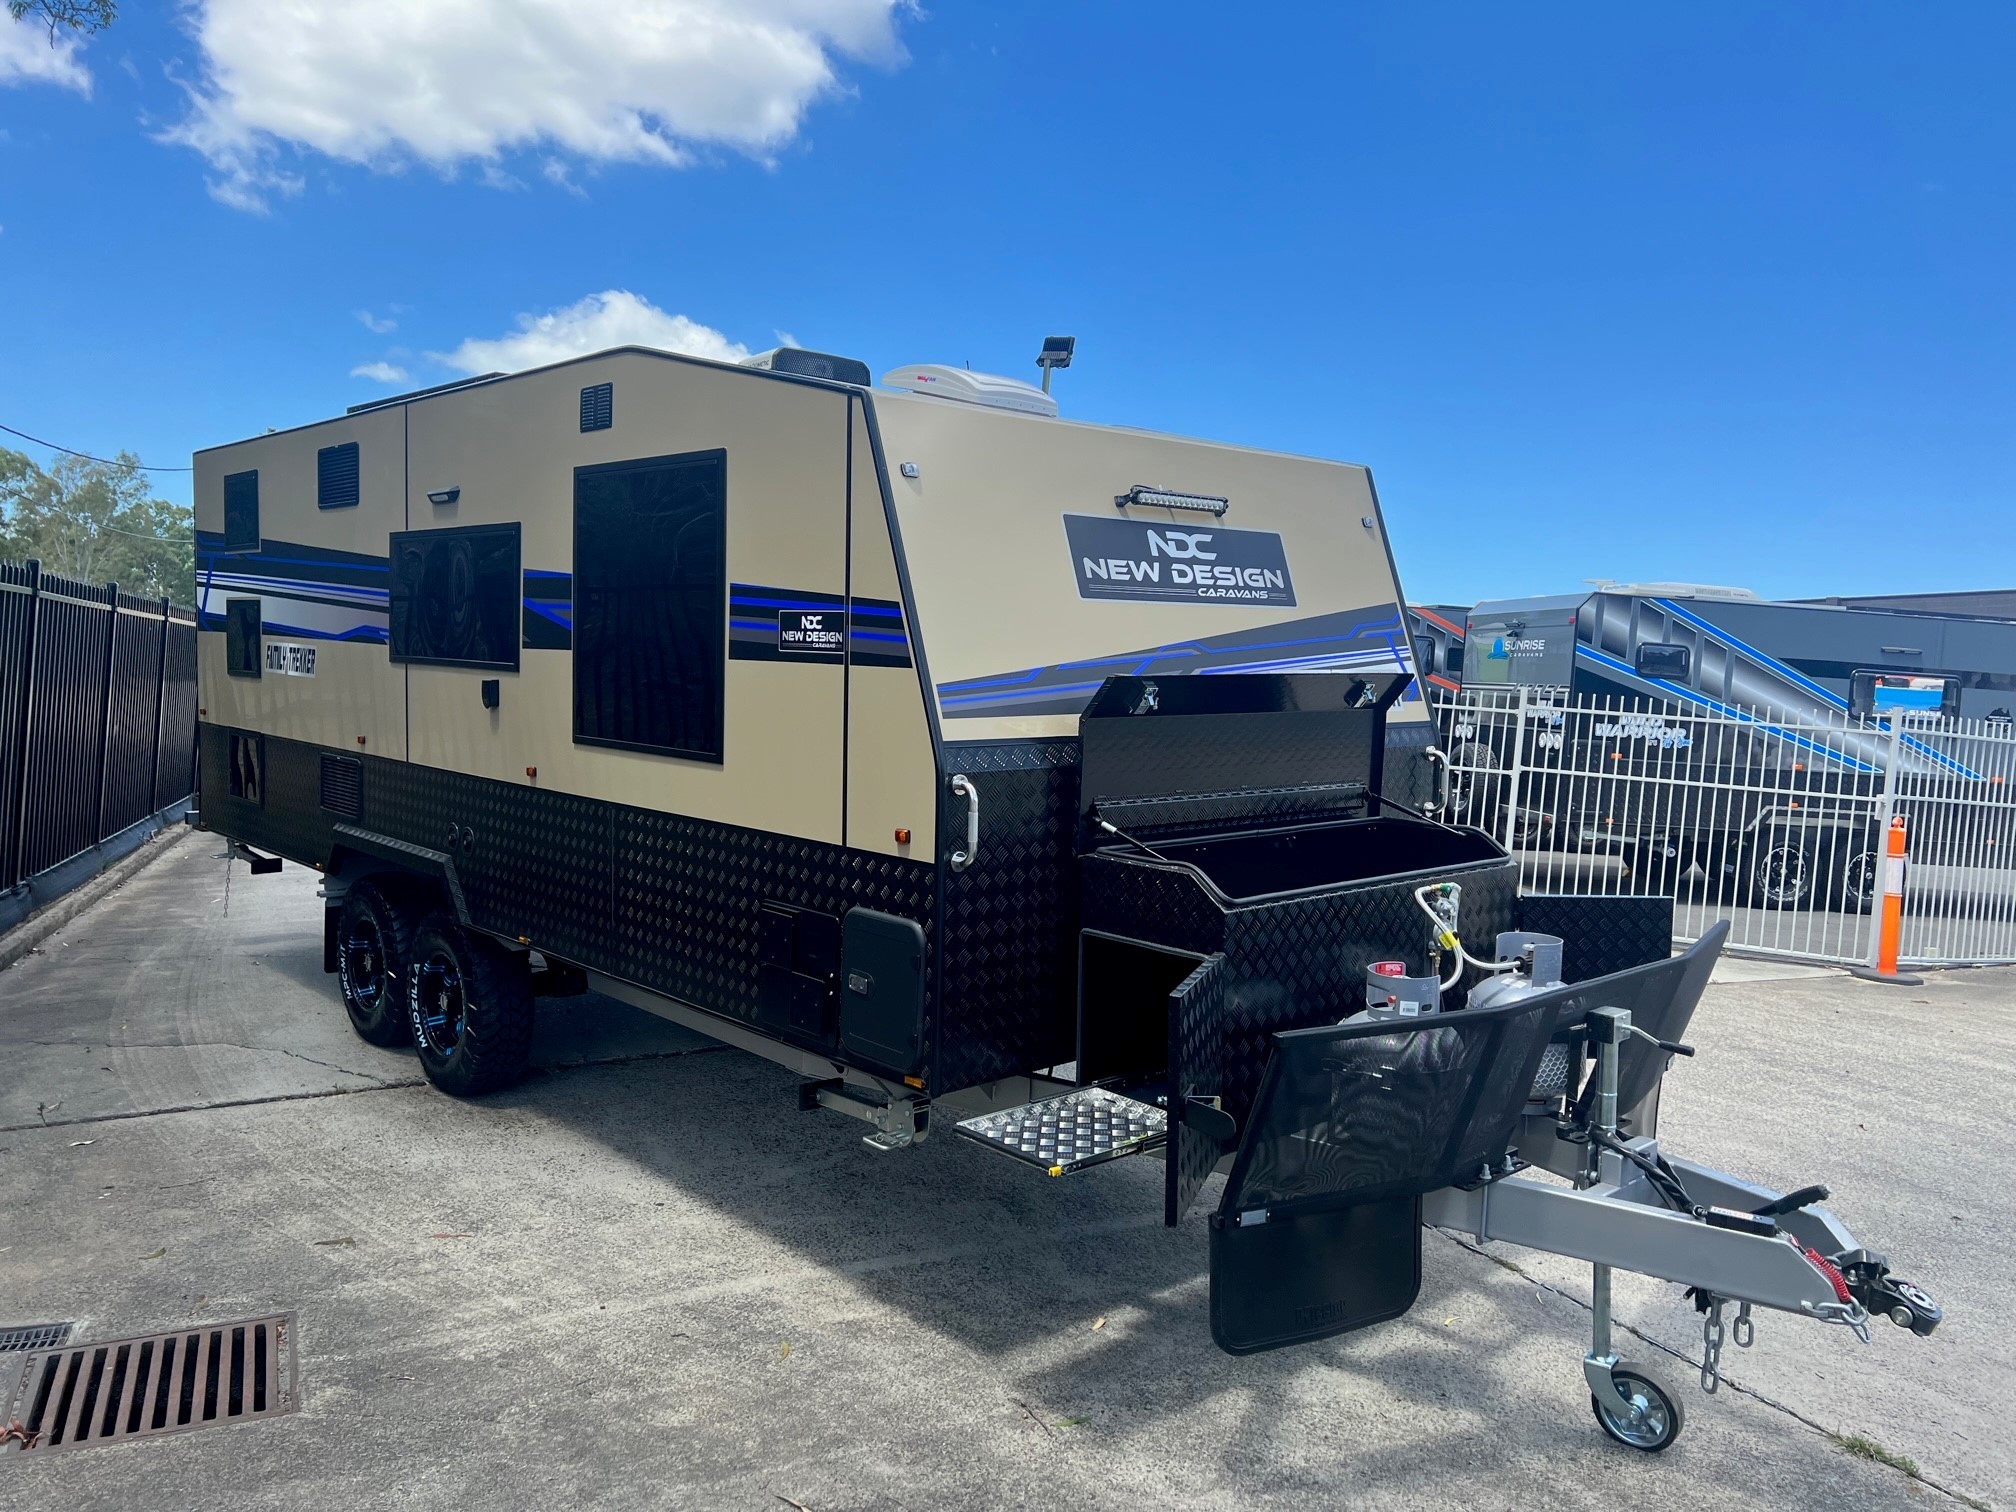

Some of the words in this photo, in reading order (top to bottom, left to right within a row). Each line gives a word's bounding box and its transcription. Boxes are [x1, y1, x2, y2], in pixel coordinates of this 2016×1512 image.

[1146, 528, 1217, 561] NDC
[1082, 557, 1160, 583] NEW
[1171, 563, 1285, 589] DESIGN
[1197, 587, 1269, 600] CARAVANS
[801, 615, 823, 630] NDC
[781, 630, 804, 642] NEW
[805, 631, 843, 643] DESIGN
[1504, 639, 1546, 651] SUNRISE
[265, 644, 288, 671] FAMILY
[288, 646, 315, 675] TREKKER
[411, 963, 428, 1048] MUDZILLA
